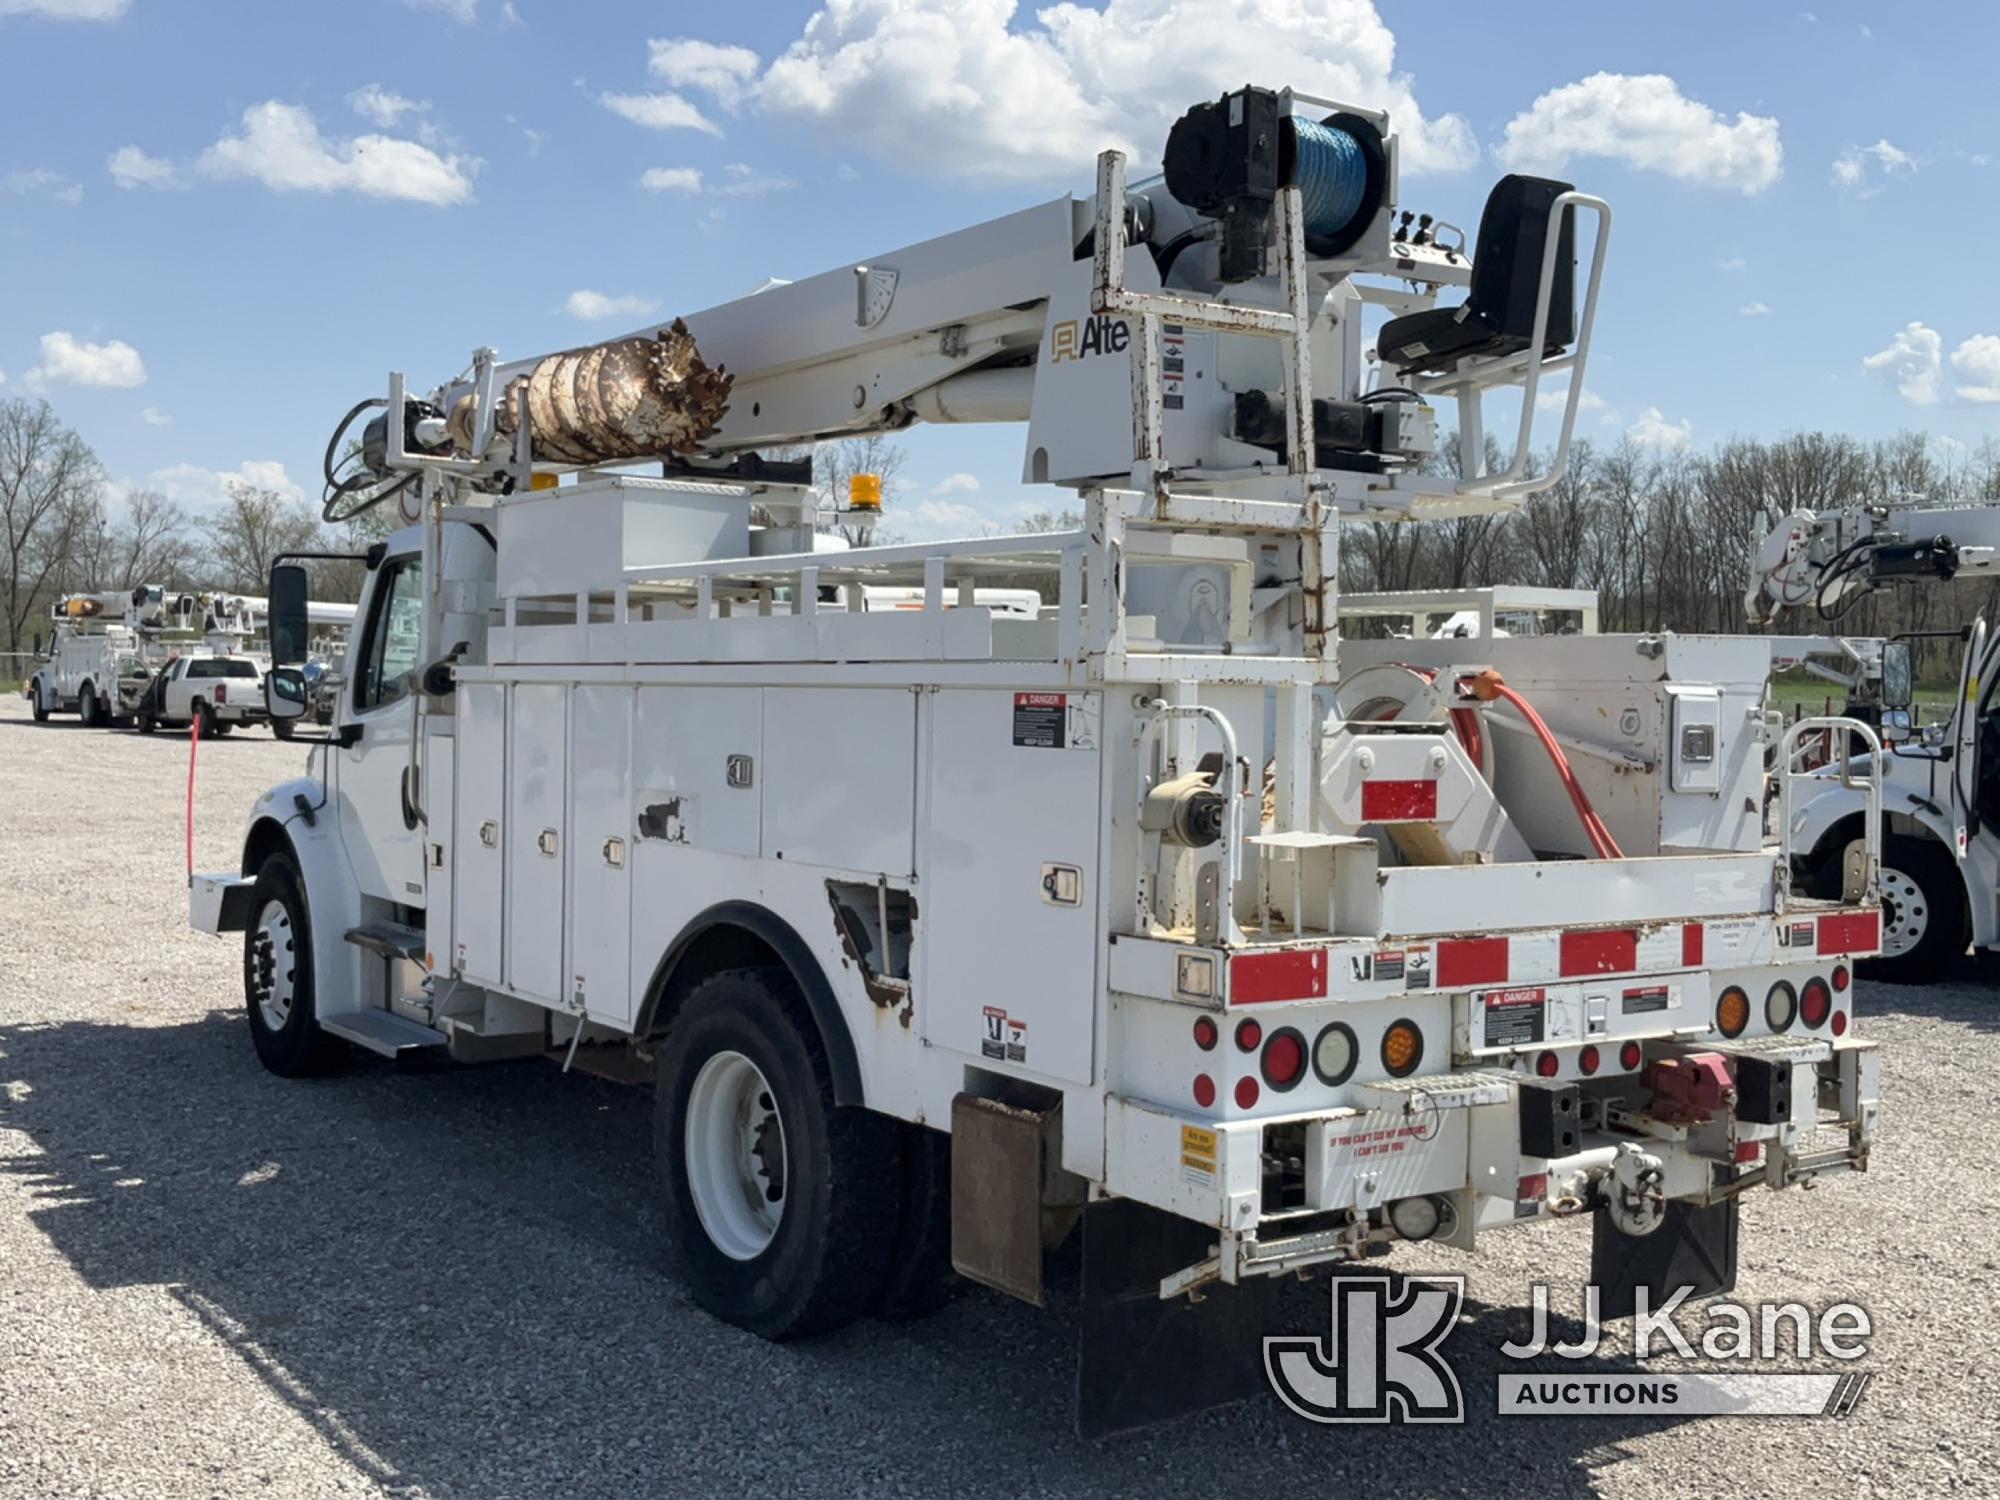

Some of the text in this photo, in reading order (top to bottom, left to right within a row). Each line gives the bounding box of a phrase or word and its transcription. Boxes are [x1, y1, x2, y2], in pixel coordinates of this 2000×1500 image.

[1080, 315, 1130, 359] Alte
[1029, 694, 1060, 705] DANGER
[1503, 991, 1537, 1003] DANGER
[1498, 1037, 1513, 1045] KEEP
[1339, 1136, 1352, 1146] YOU
[1374, 1131, 1385, 1140] SEE
[1386, 1129, 1396, 1138] MY
[1379, 1143, 1390, 1153] SEE
[1391, 1141, 1404, 1151] YOU
